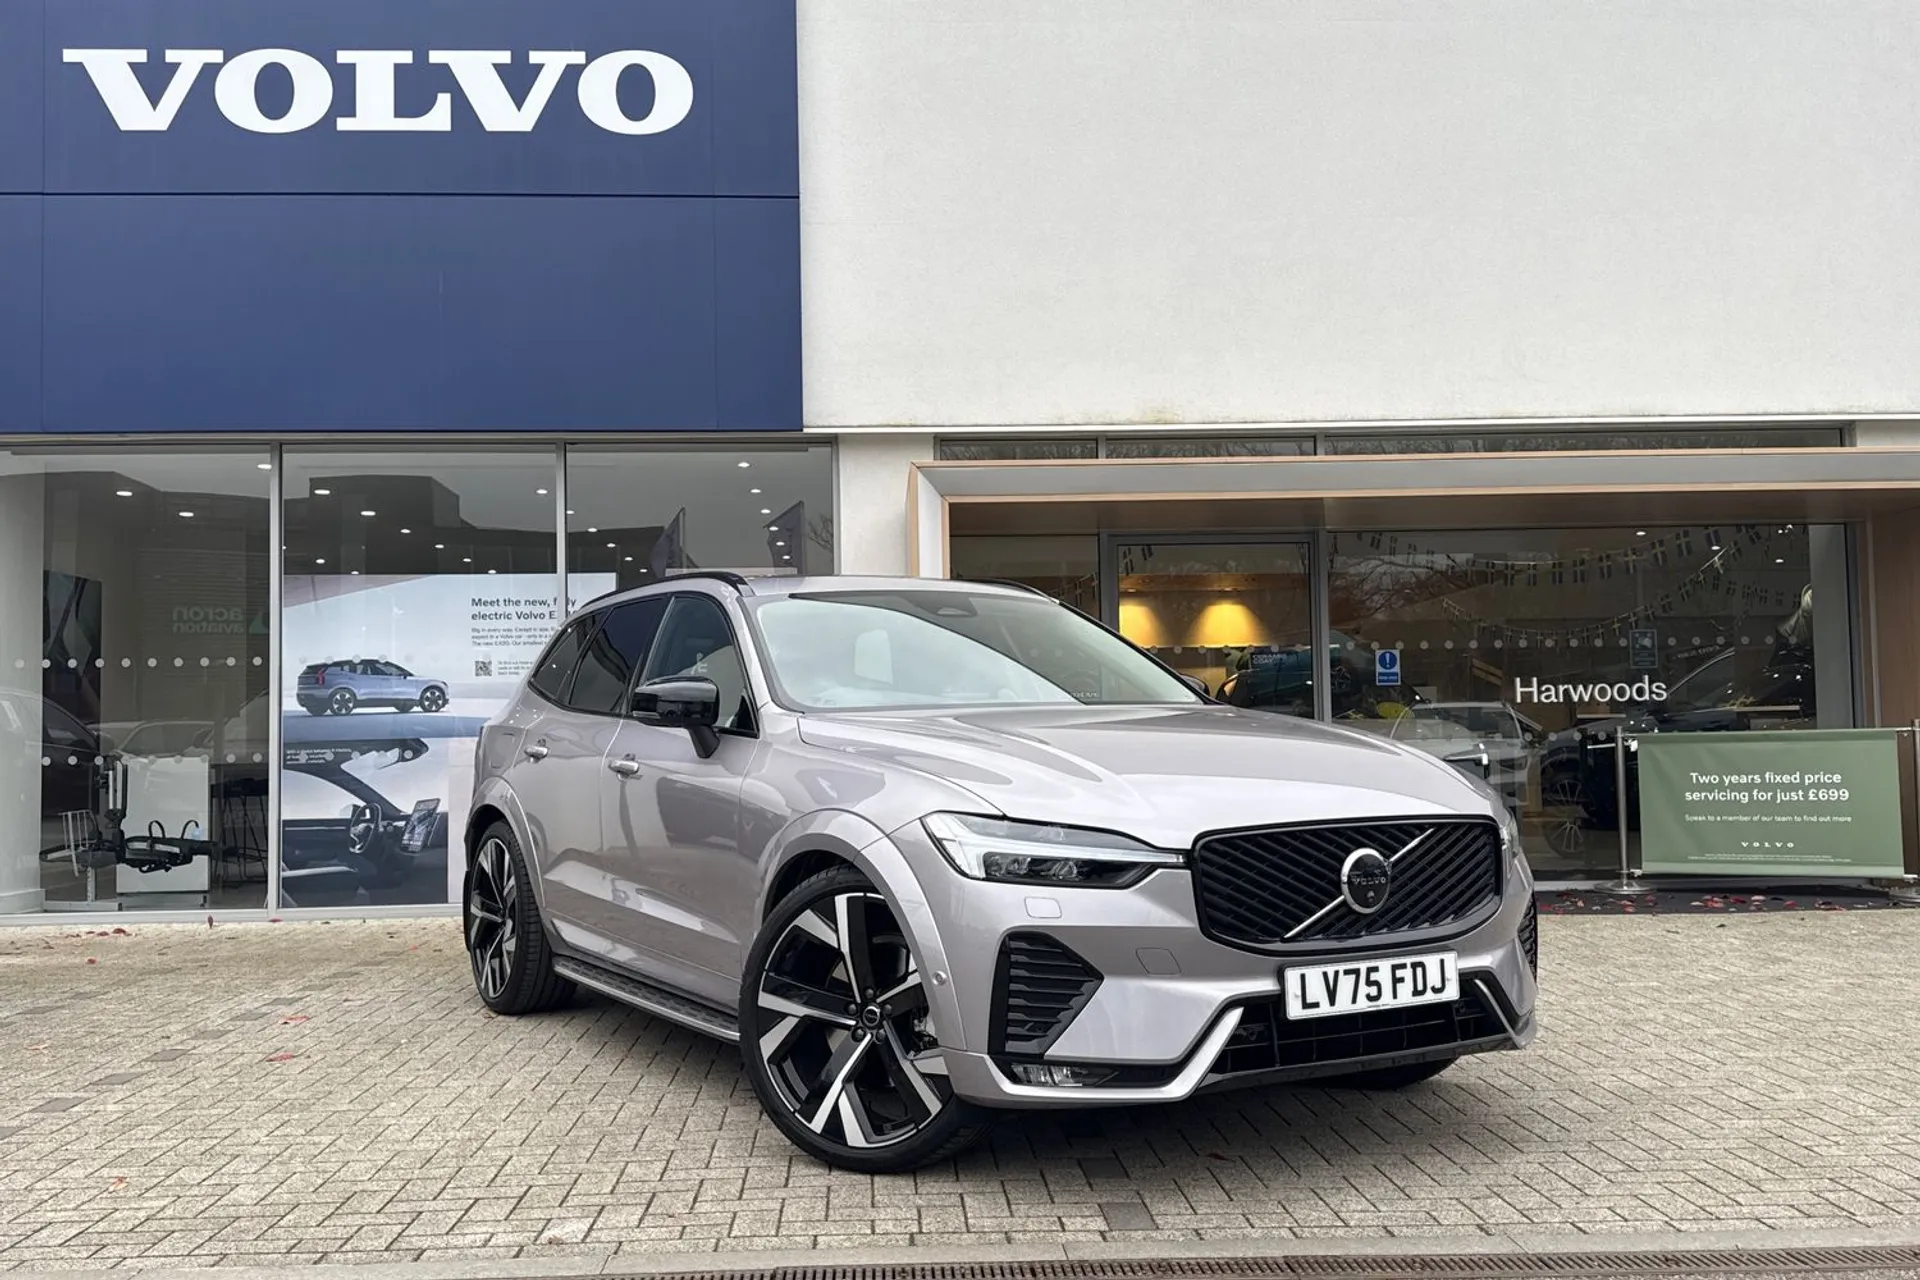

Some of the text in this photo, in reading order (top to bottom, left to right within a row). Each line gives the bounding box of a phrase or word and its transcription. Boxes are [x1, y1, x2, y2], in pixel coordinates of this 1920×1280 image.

[62, 48, 694, 135] VOLVO
[471, 598, 500, 607] Meet
[503, 597, 522, 607] the
[524, 599, 550, 608] new,
[471, 611, 512, 620] electric
[514, 610, 546, 620] Volvo
[1515, 674, 1668, 702] Harwoods
[1689, 771, 1842, 786] Two years fixed price
[1684, 788, 1850, 804] servicing for just £699
[1684, 814, 1706, 822] Speak
[1722, 814, 1751, 822] member
[1752, 814, 1760, 822] of
[1803, 814, 1817, 822] find
[1300, 958, 1447, 1010] LV75 FDJ
